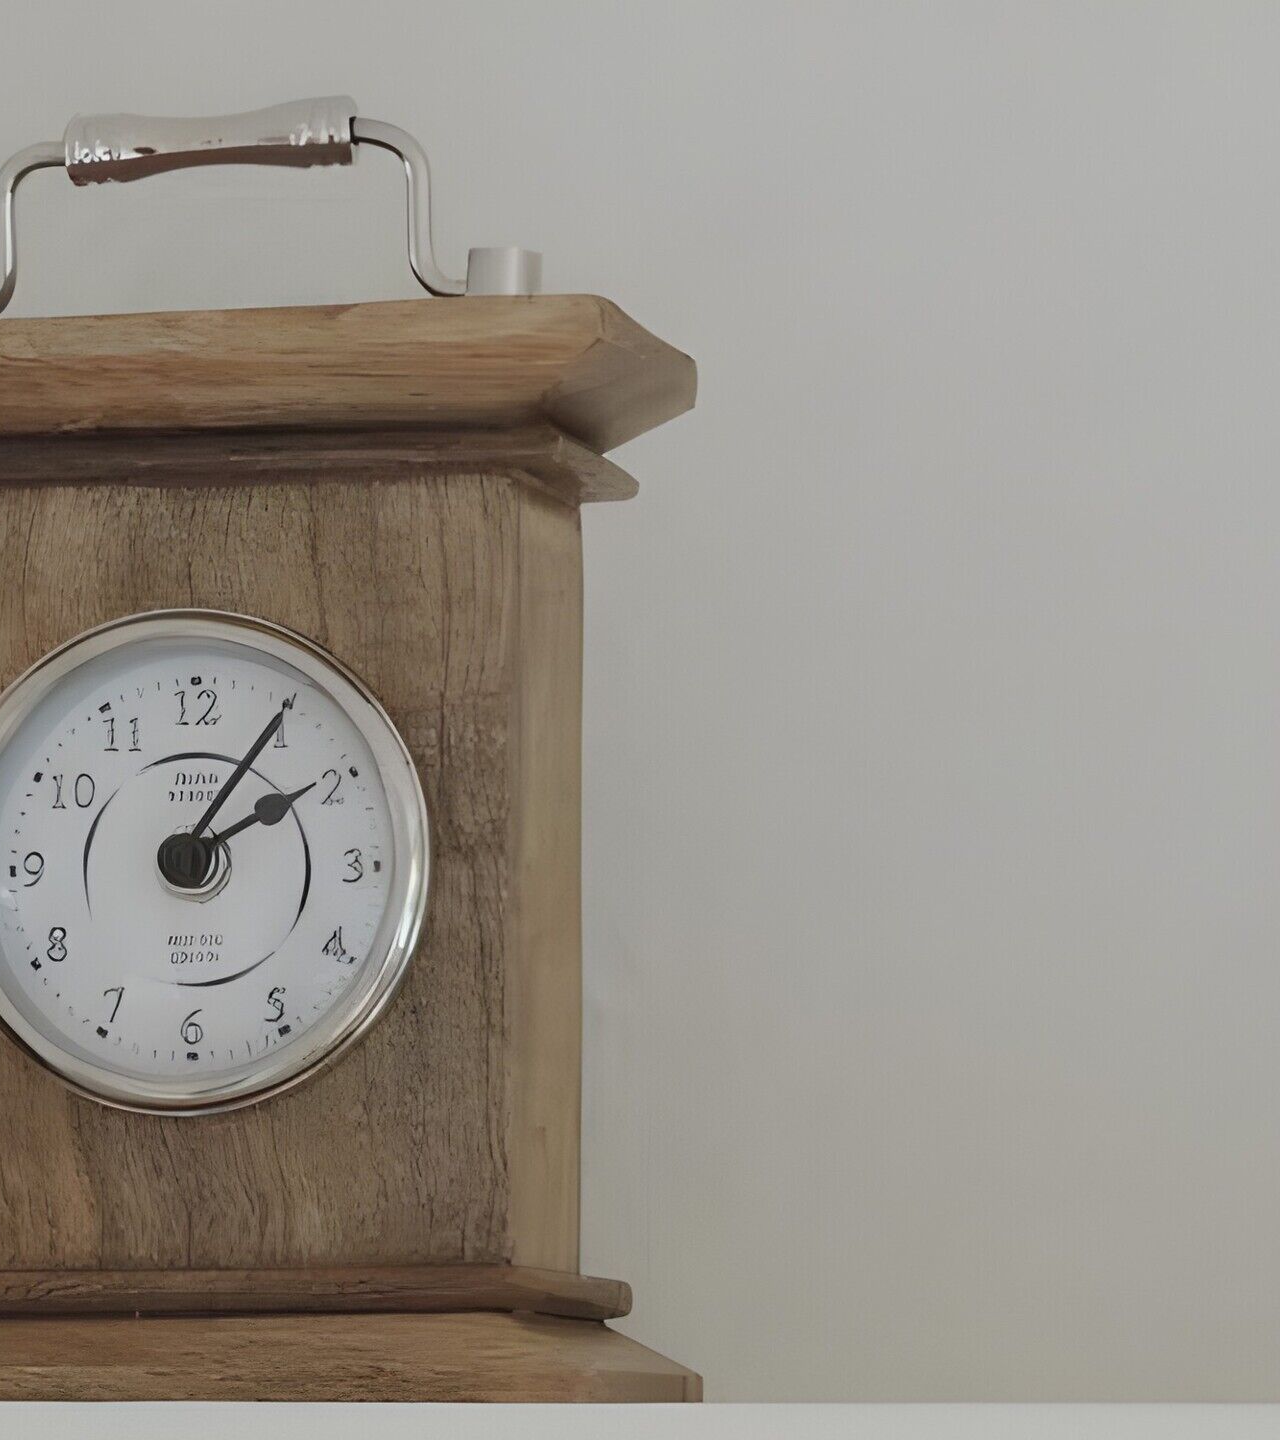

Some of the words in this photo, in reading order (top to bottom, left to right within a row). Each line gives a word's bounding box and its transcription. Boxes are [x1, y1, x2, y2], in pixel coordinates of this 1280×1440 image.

[174, 689, 223, 726] 12
[102, 717, 142, 752] 11
[52, 773, 95, 809] 10
[321, 769, 344, 805] 2
[23, 851, 44, 887] 9
[342, 848, 364, 883] 3
[46, 927, 68, 962] 8
[103, 986, 125, 1023] 7
[264, 987, 287, 1023] 5
[179, 1009, 204, 1046] 6
